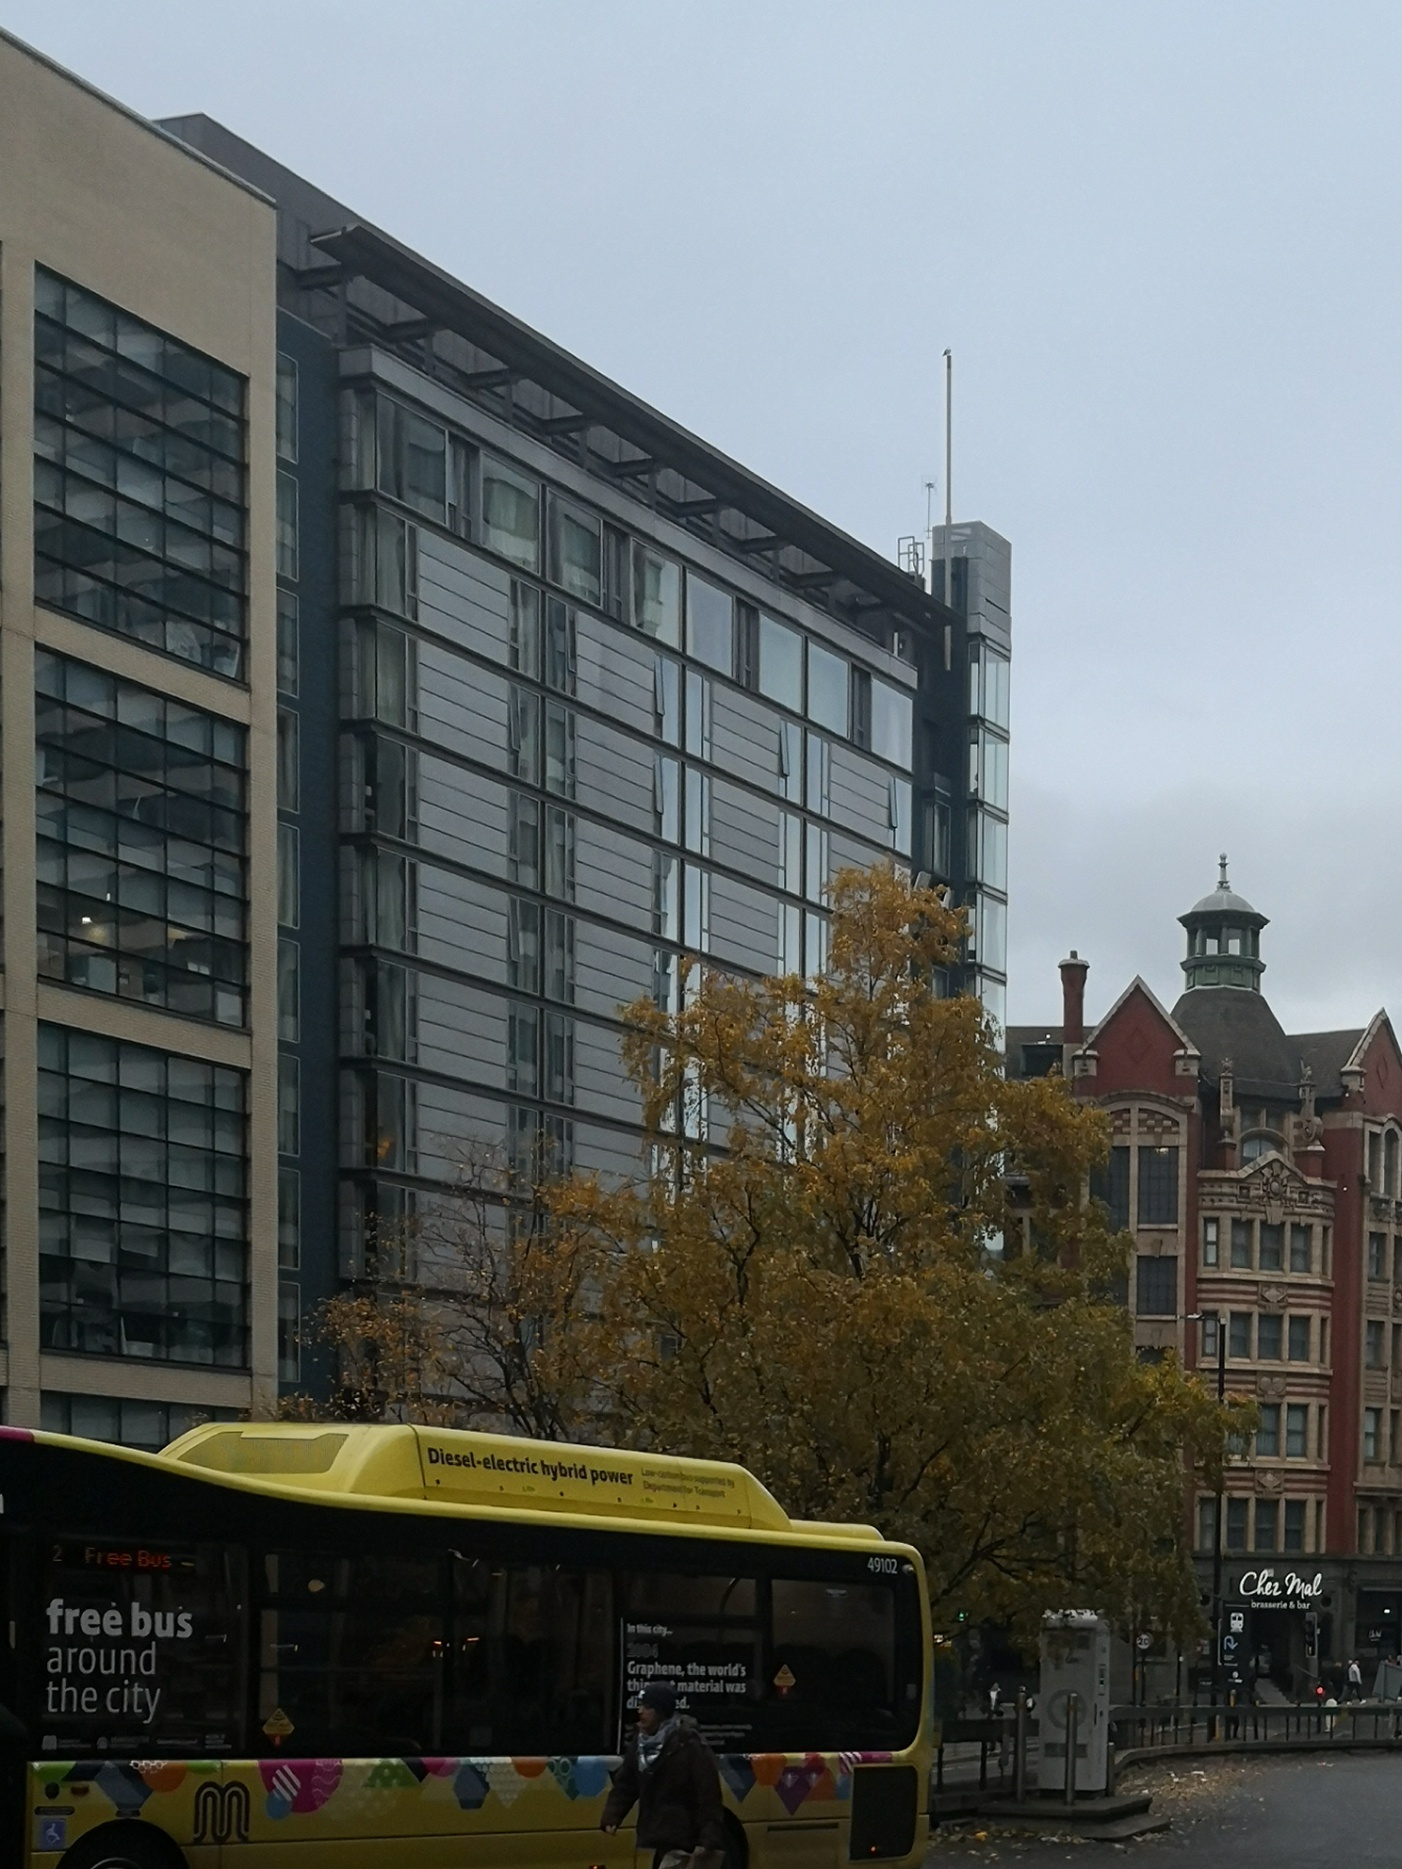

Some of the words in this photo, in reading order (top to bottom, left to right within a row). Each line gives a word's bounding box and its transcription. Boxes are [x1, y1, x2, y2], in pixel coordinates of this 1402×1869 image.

[427, 1447, 538, 1475] Diesel-electric
[540, 1459, 587, 1481] hybrid
[590, 1468, 634, 1486] power
[84, 1547, 133, 1567] Free
[136, 1549, 173, 1569] Bus
[867, 1557, 898, 1574] 49102
[1239, 1569, 1282, 1596] Chez
[1284, 1572, 1323, 1600] Mal
[1250, 1599, 1288, 1609] brasserie
[1289, 1601, 1296, 1609] &
[1297, 1600, 1311, 1609] bar
[46, 1598, 124, 1635] free
[130, 1601, 194, 1638] bus
[627, 1623, 636, 1634] In
[46, 1640, 156, 1676] around
[627, 1660, 685, 1679] Graphene,
[687, 1662, 706, 1676] the
[707, 1663, 747, 1678] world's
[677, 1680, 724, 1693] material
[725, 1683, 747, 1694] was
[46, 1677, 98, 1713] the
[106, 1679, 162, 1725] city
